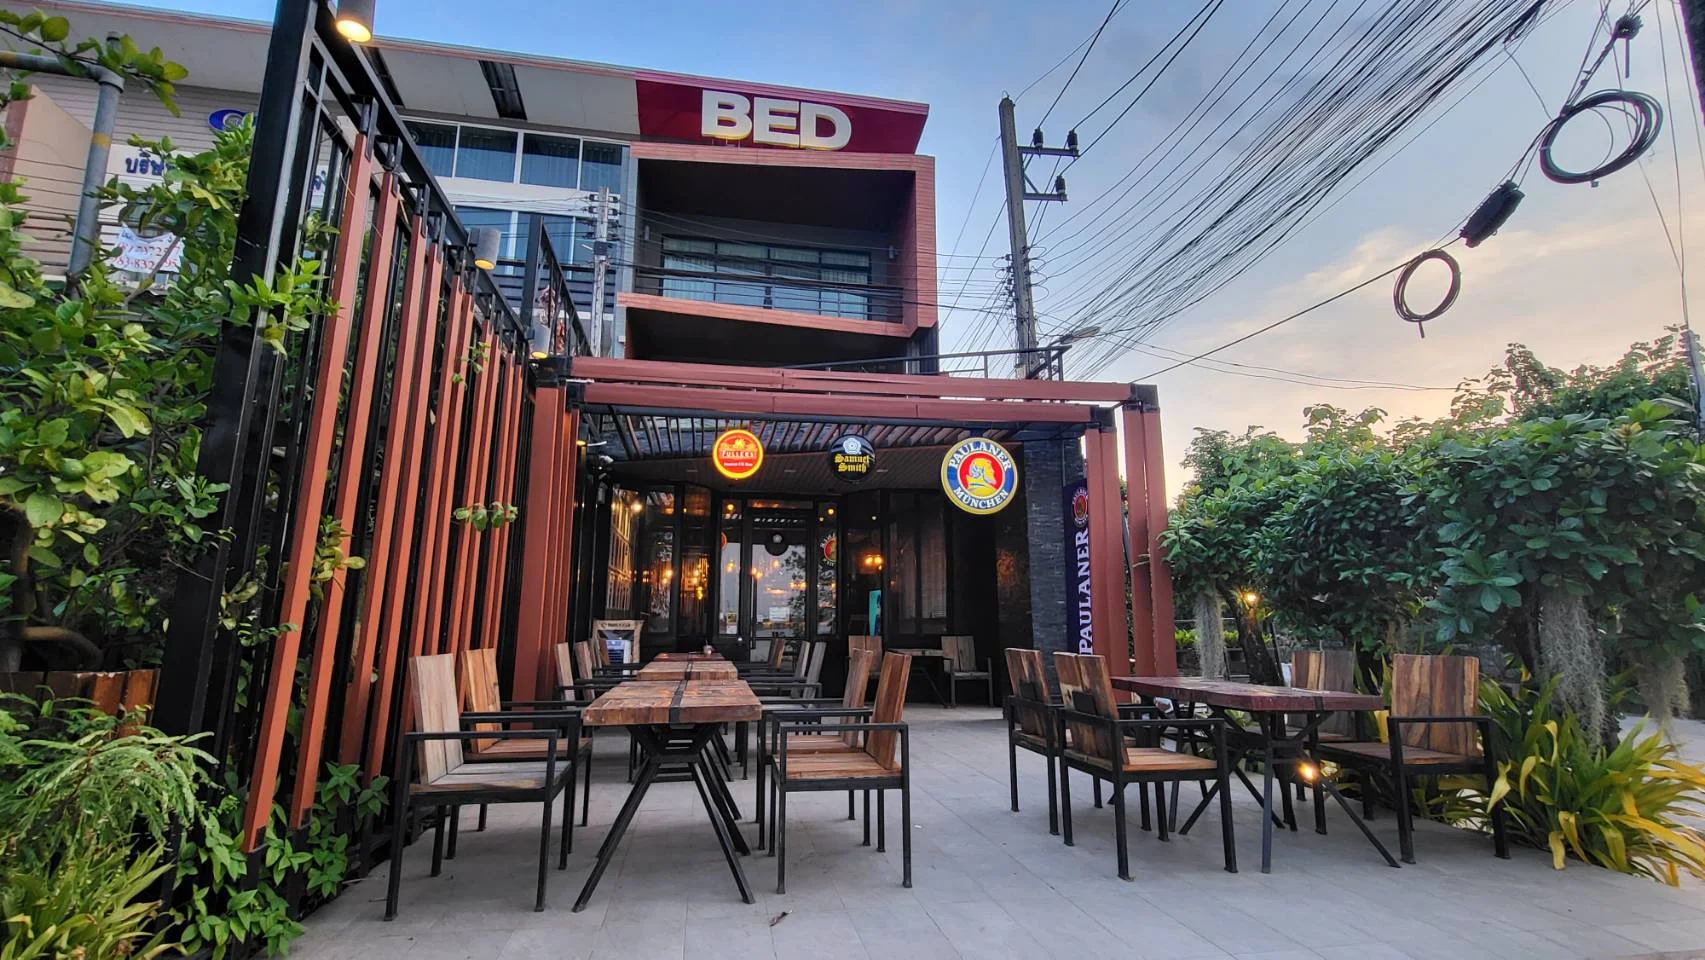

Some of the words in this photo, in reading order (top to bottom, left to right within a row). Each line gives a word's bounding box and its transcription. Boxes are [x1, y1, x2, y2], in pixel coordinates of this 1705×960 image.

[701, 89, 852, 151] BED
[834, 453, 870, 463] Samuel
[837, 462, 867, 473] Smith
[948, 441, 1012, 471] PAULANER
[1076, 527, 1093, 655] PAULANER
